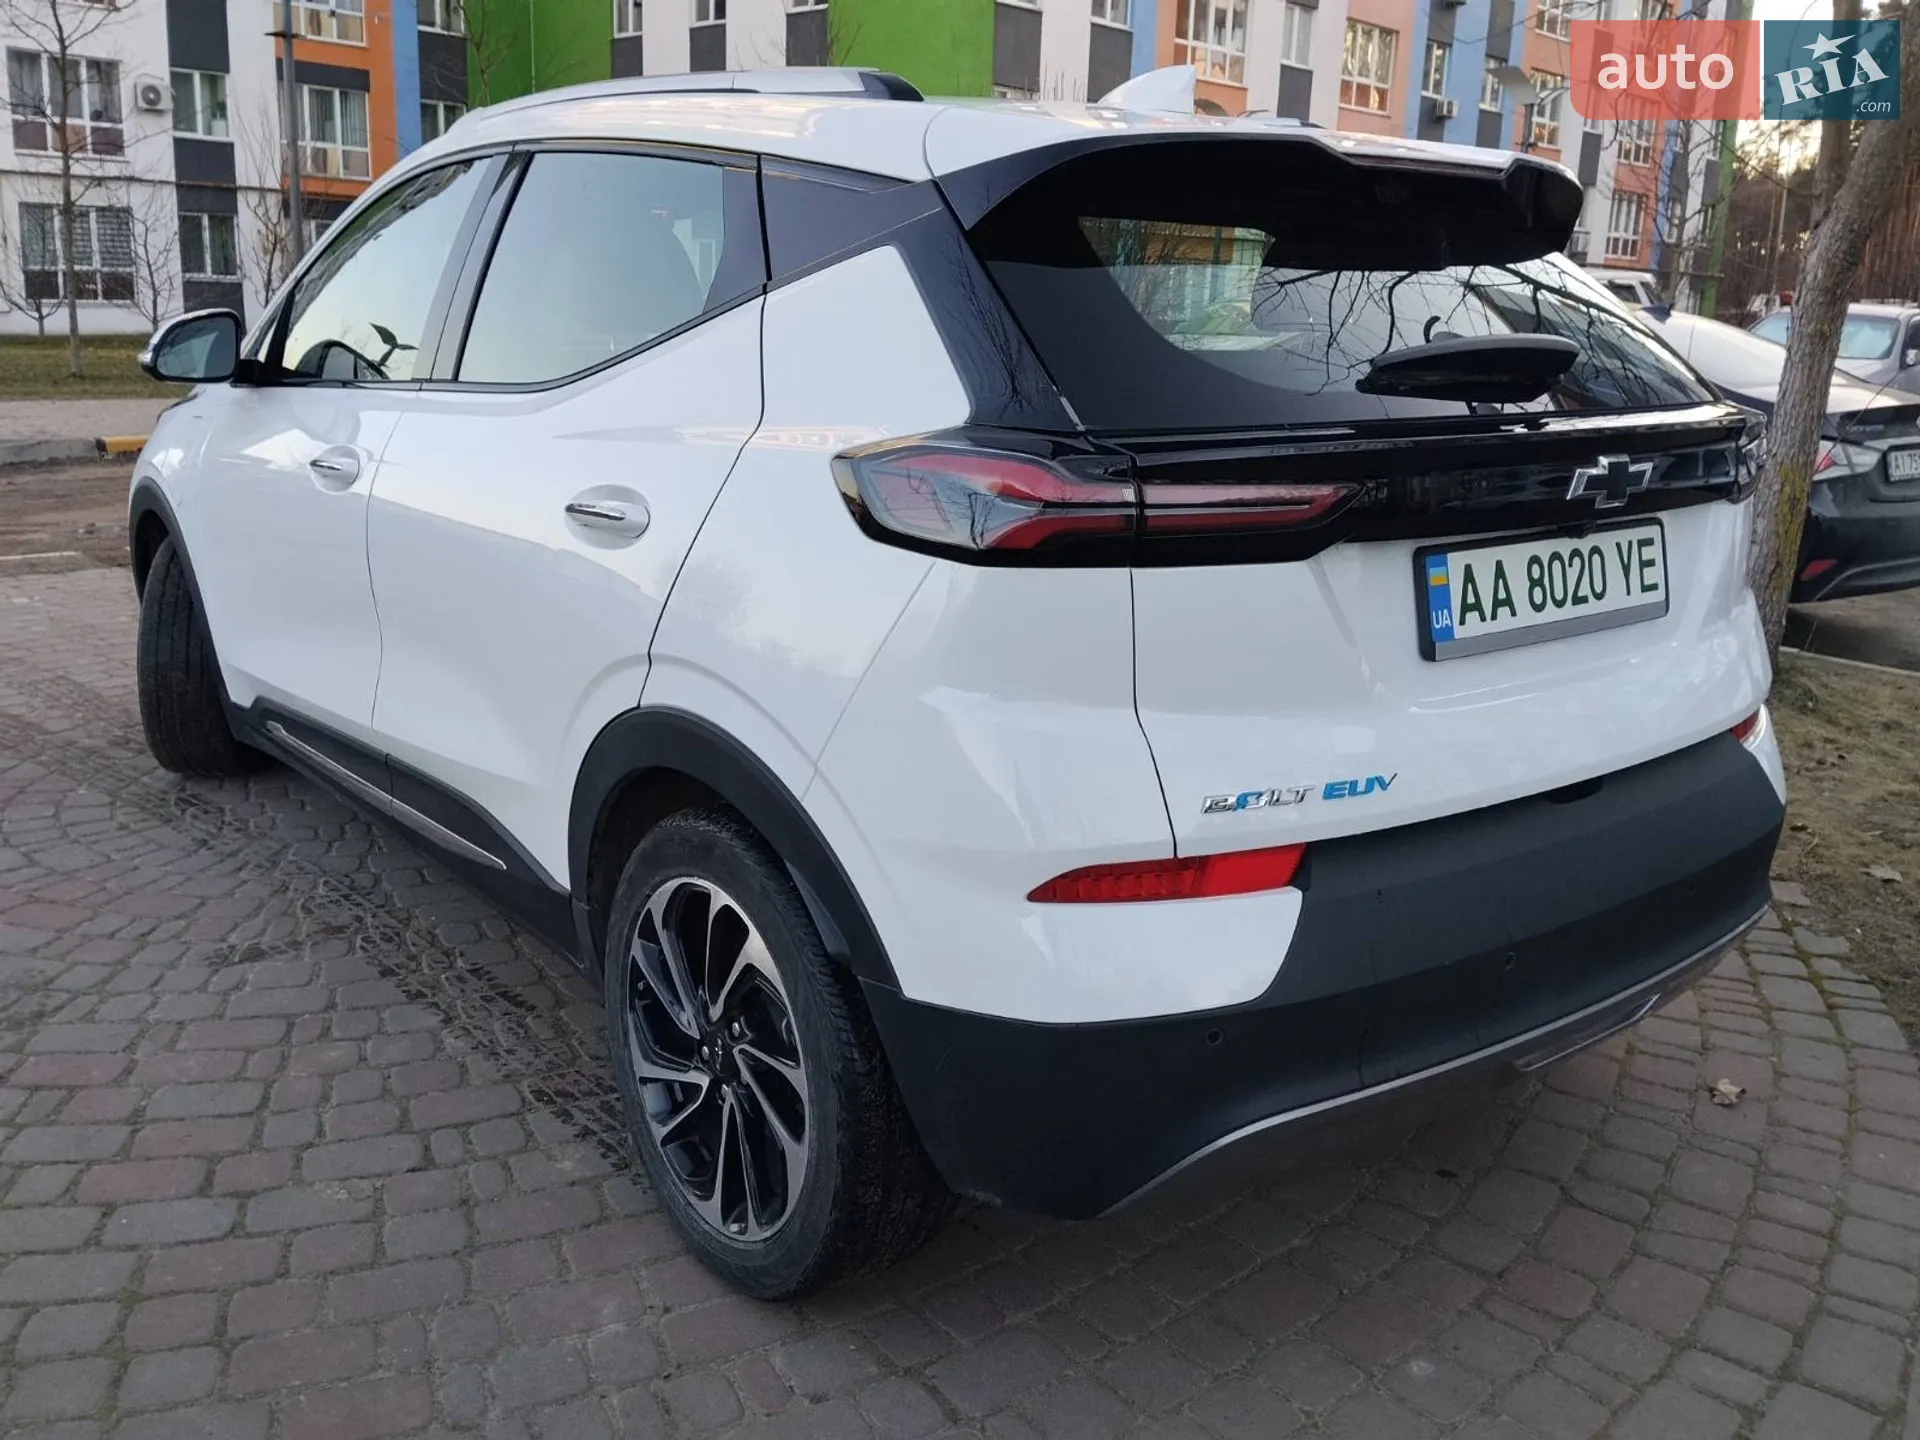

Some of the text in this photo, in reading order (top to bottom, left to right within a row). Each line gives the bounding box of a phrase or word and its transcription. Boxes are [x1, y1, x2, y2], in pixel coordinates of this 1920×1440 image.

[1459, 537, 1659, 626] AA 8020 YE
[1432, 609, 1452, 629] UA
[1322, 773, 1398, 800] EUV
